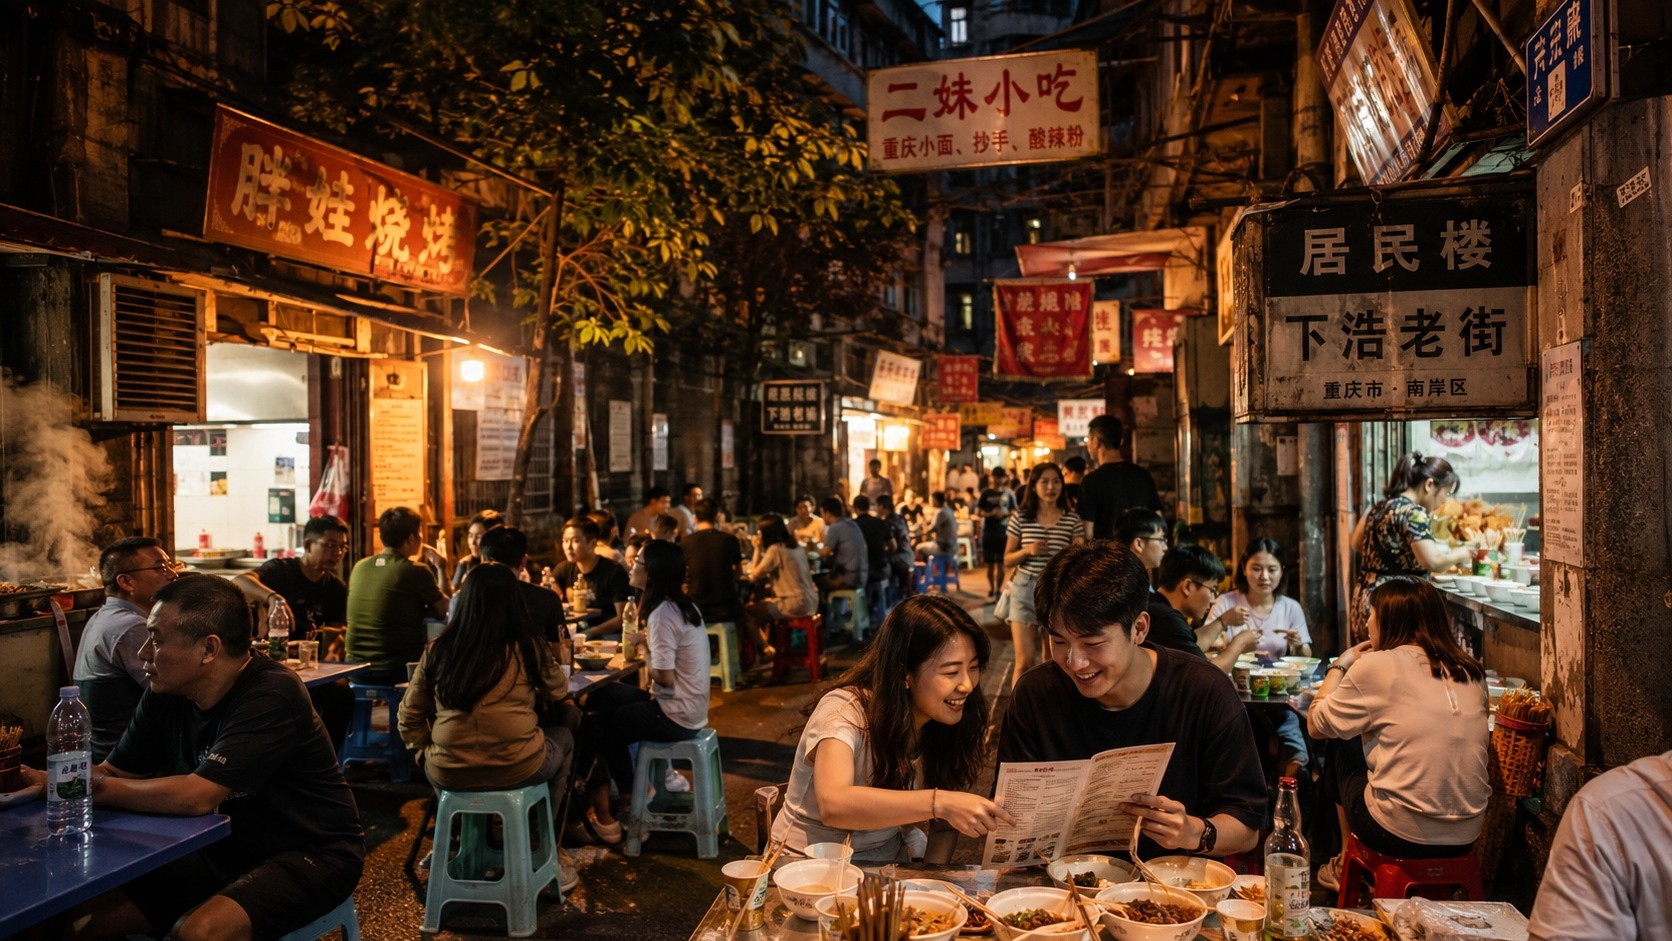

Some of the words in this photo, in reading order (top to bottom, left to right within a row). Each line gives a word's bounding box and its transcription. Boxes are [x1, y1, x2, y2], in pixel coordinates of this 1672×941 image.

[882, 62, 1084, 122] 二妹小吃
[883, 125, 1084, 160] 重庆小面、抄手、酸辣粉
[231, 142, 458, 274] 胖娃烧烤
[1300, 219, 1492, 276] 居民楼
[1285, 306, 1507, 362] 下浩老街
